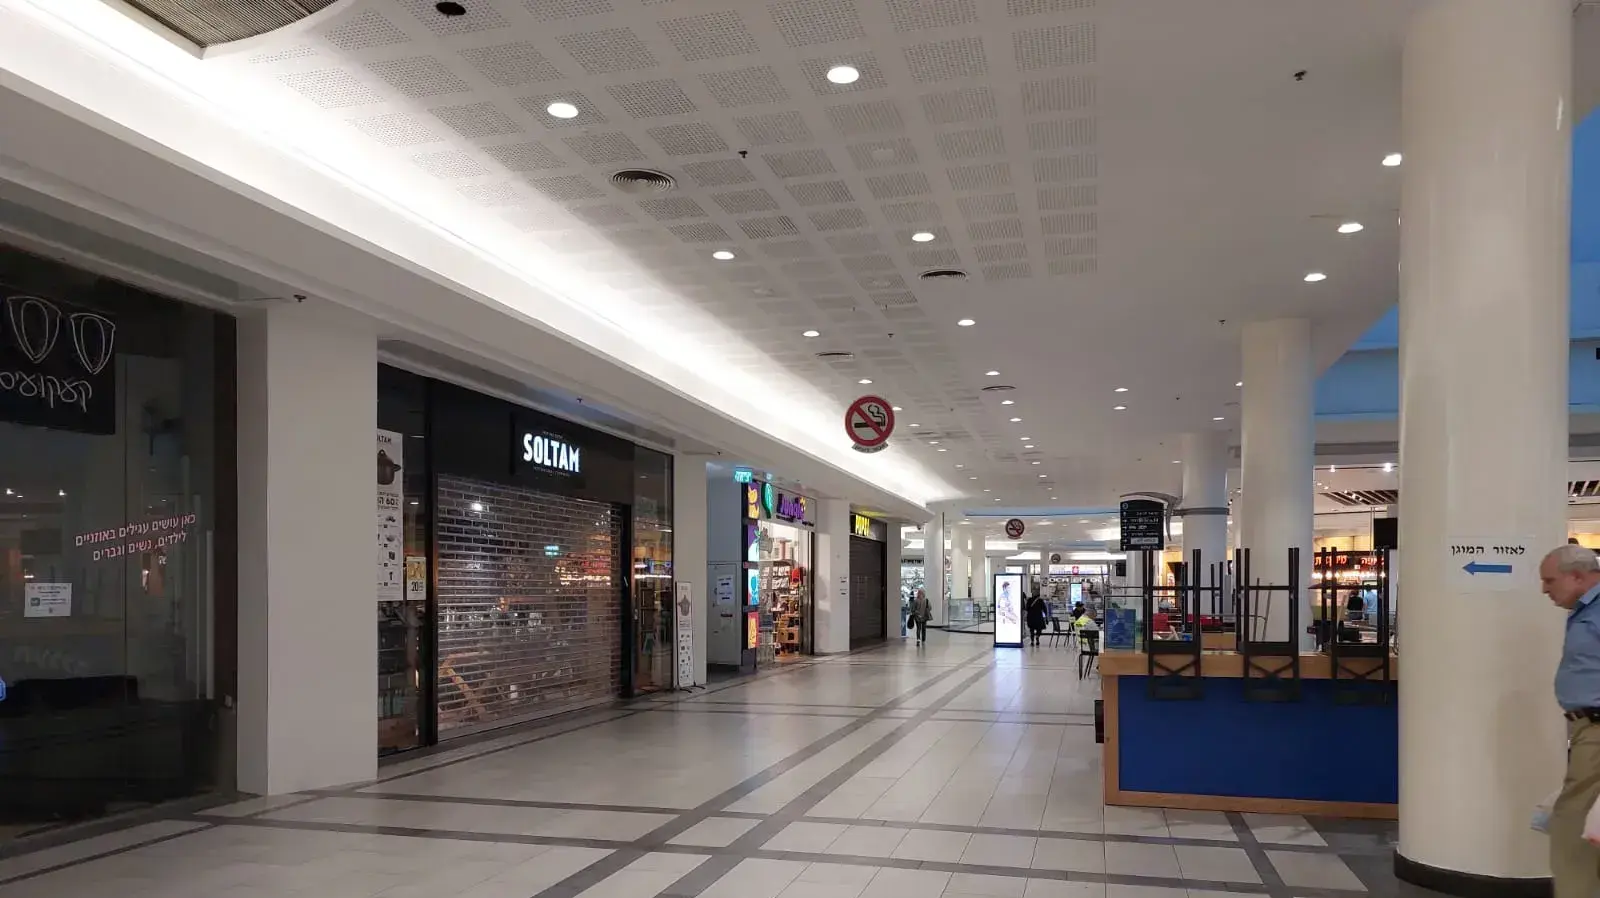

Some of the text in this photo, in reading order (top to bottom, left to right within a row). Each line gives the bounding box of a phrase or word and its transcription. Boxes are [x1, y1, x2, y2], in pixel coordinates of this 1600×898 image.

[523, 432, 580, 473] SOLTAM
[75, 513, 196, 547] כאן עושים עגילים באוזניים
[93, 530, 188, 562] לילדים, נשים וגברים
[1451, 544, 1526, 556] לאזור המוגן
